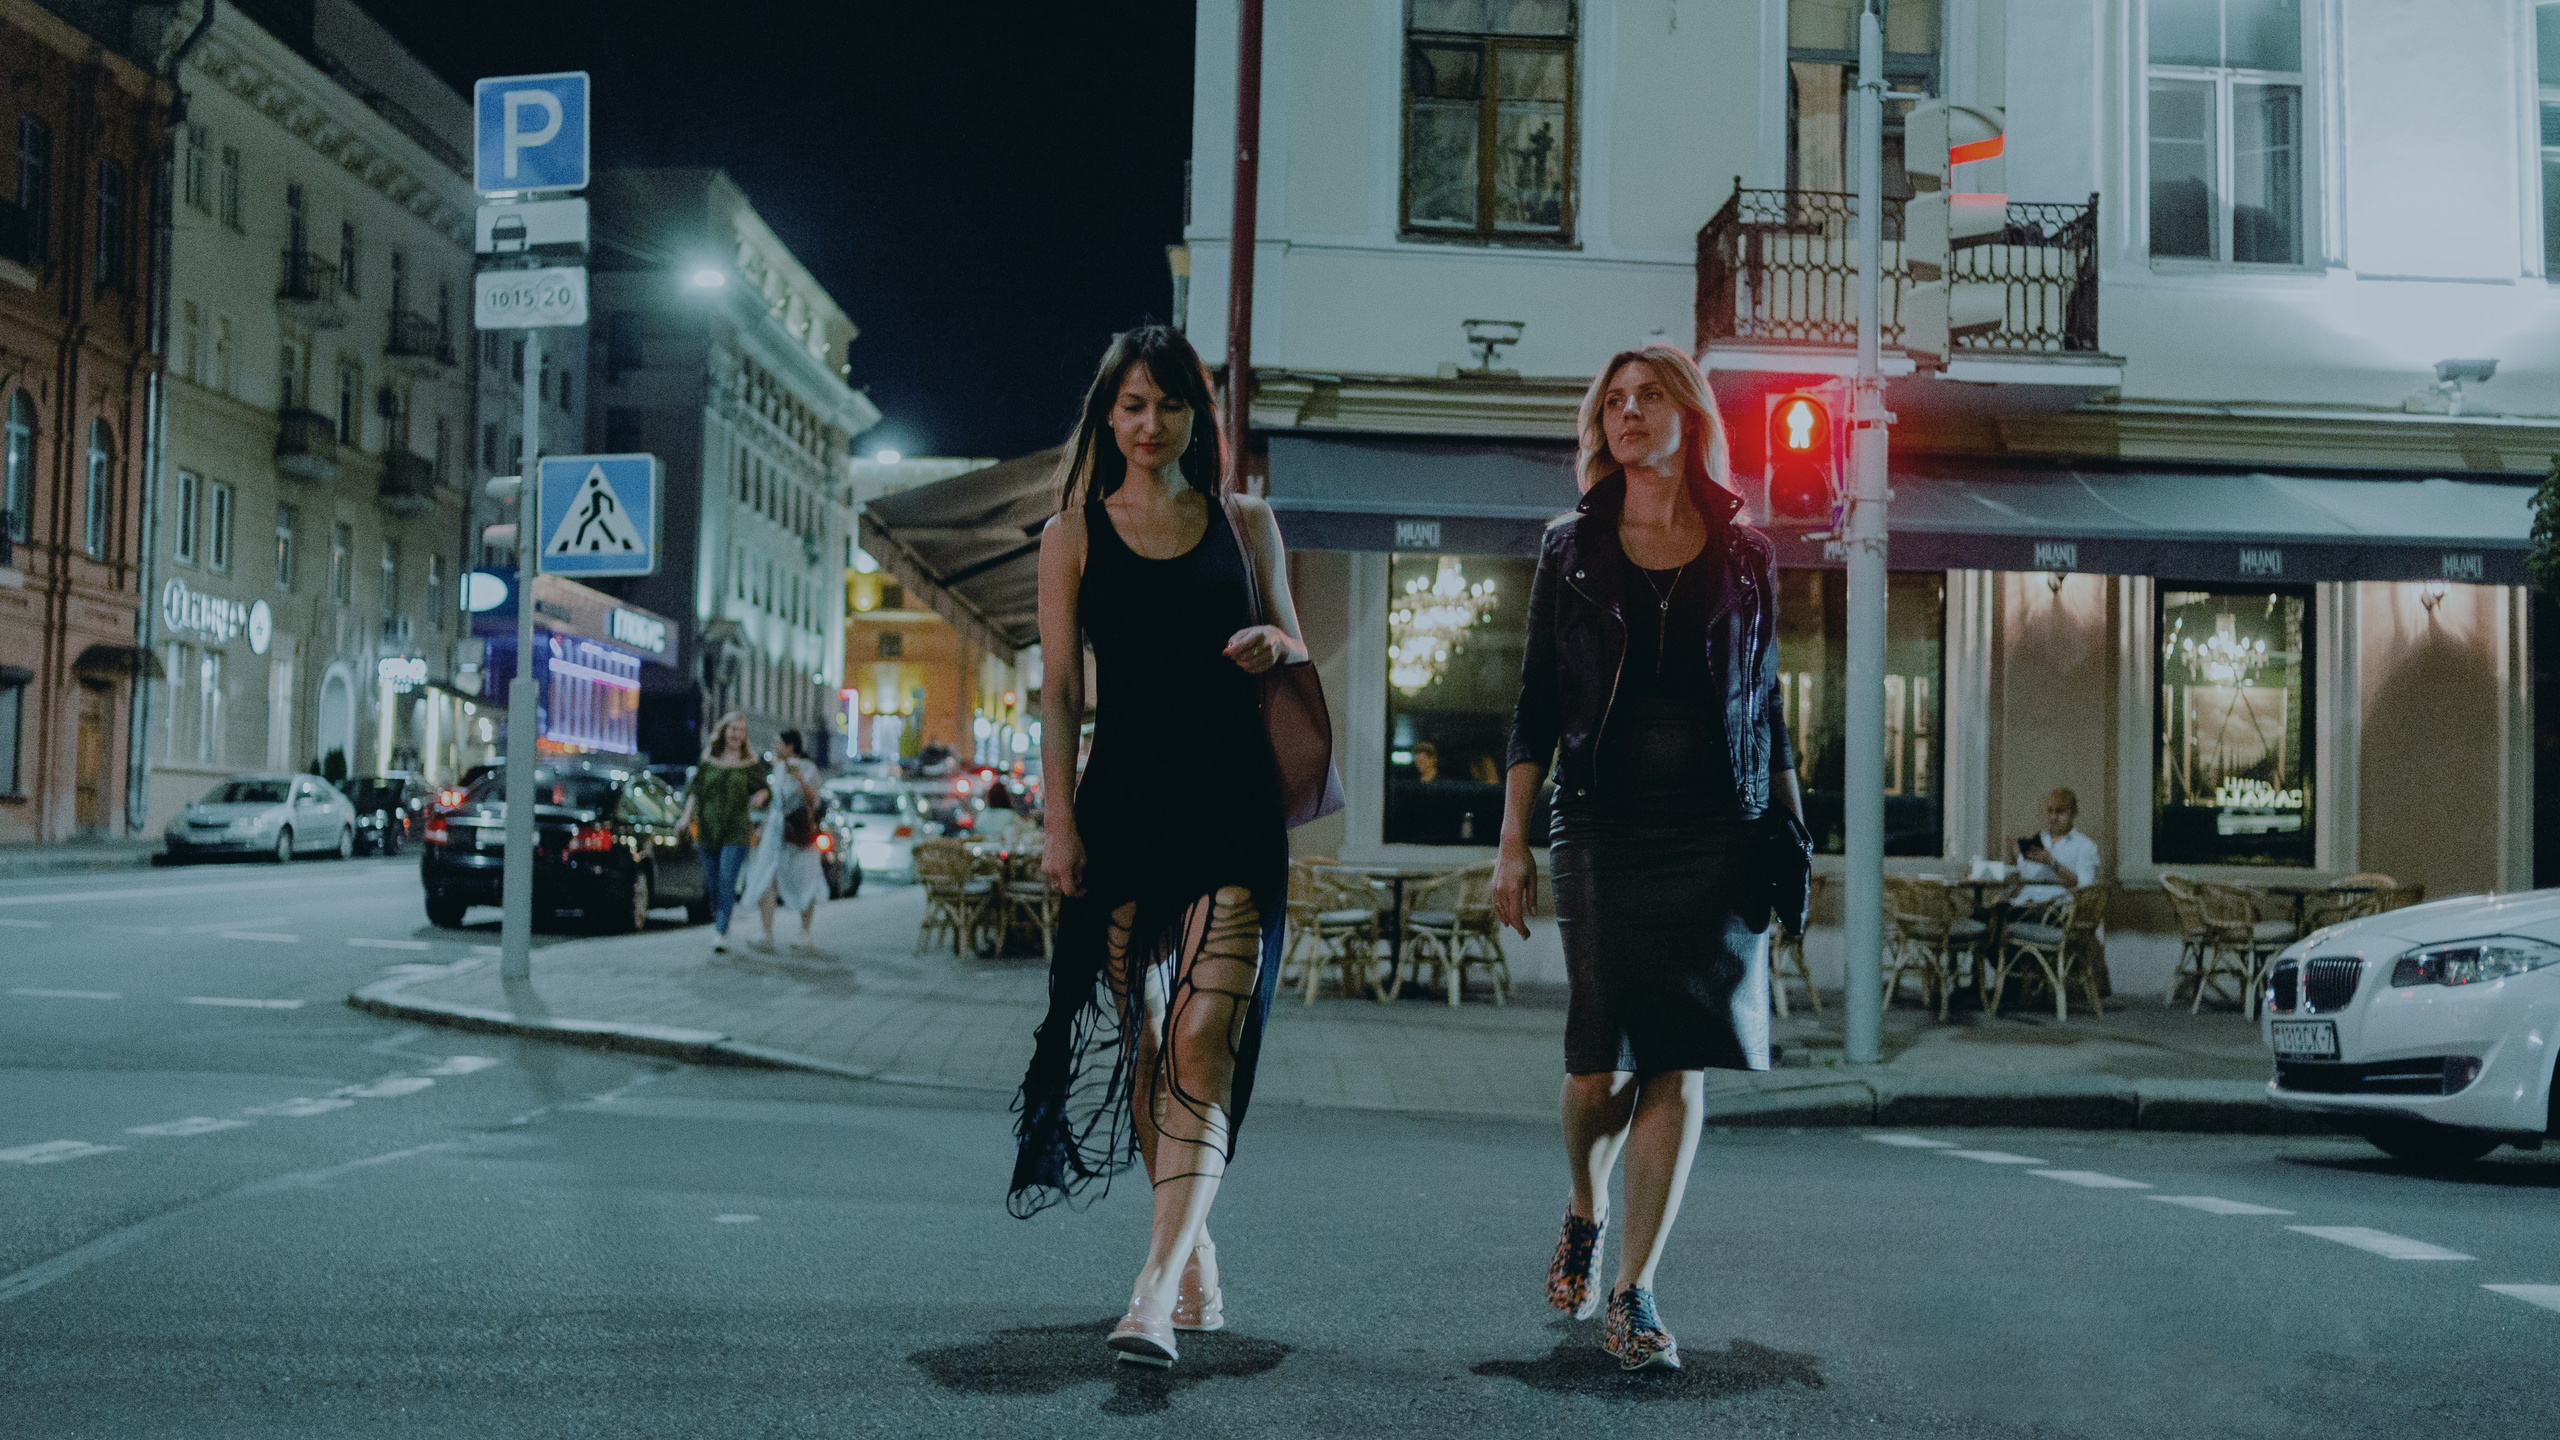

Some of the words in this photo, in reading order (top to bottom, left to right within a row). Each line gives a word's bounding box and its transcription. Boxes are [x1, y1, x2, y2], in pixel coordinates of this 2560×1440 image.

[503, 88, 563, 180] P
[492, 290, 510, 308] 10
[515, 289, 534, 307] 15
[543, 286, 571, 306] 20
[1396, 521, 1441, 548] MILANO
[2034, 542, 2078, 569] MILANO
[2240, 548, 2282, 574] MILANO
[2442, 554, 2483, 579] MILANO
